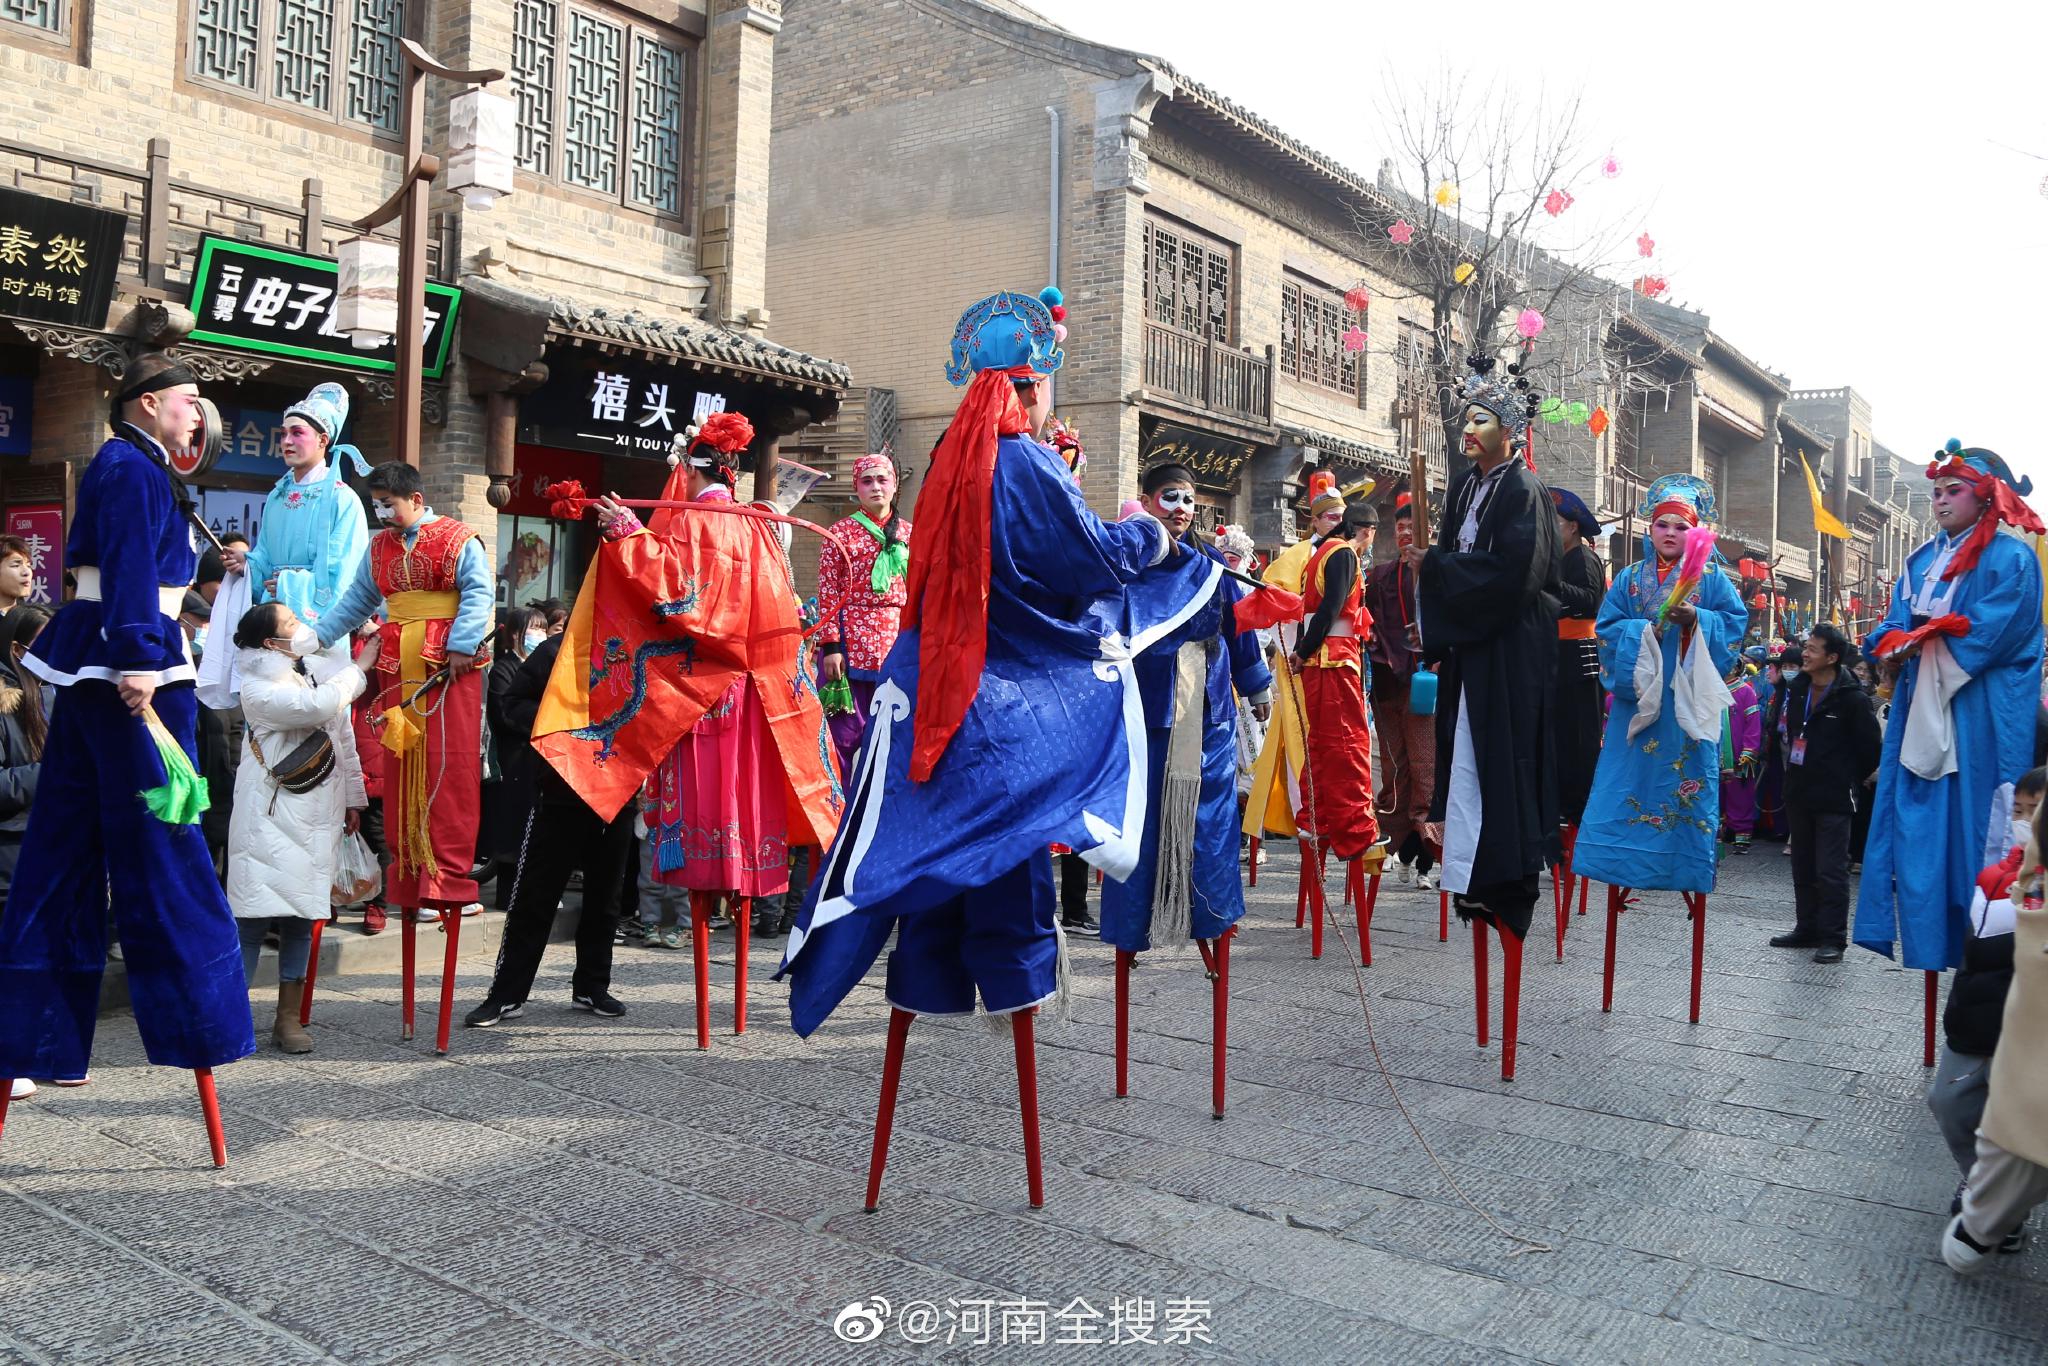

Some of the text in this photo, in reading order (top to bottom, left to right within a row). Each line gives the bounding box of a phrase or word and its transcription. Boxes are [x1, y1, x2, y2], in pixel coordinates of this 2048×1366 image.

[0, 224, 89, 276] 素然
[2, 277, 82, 305] 时尚馆
[212, 264, 245, 323] 云雾
[615, 433, 630, 447] XI
[634, 437, 661, 451] TOU
